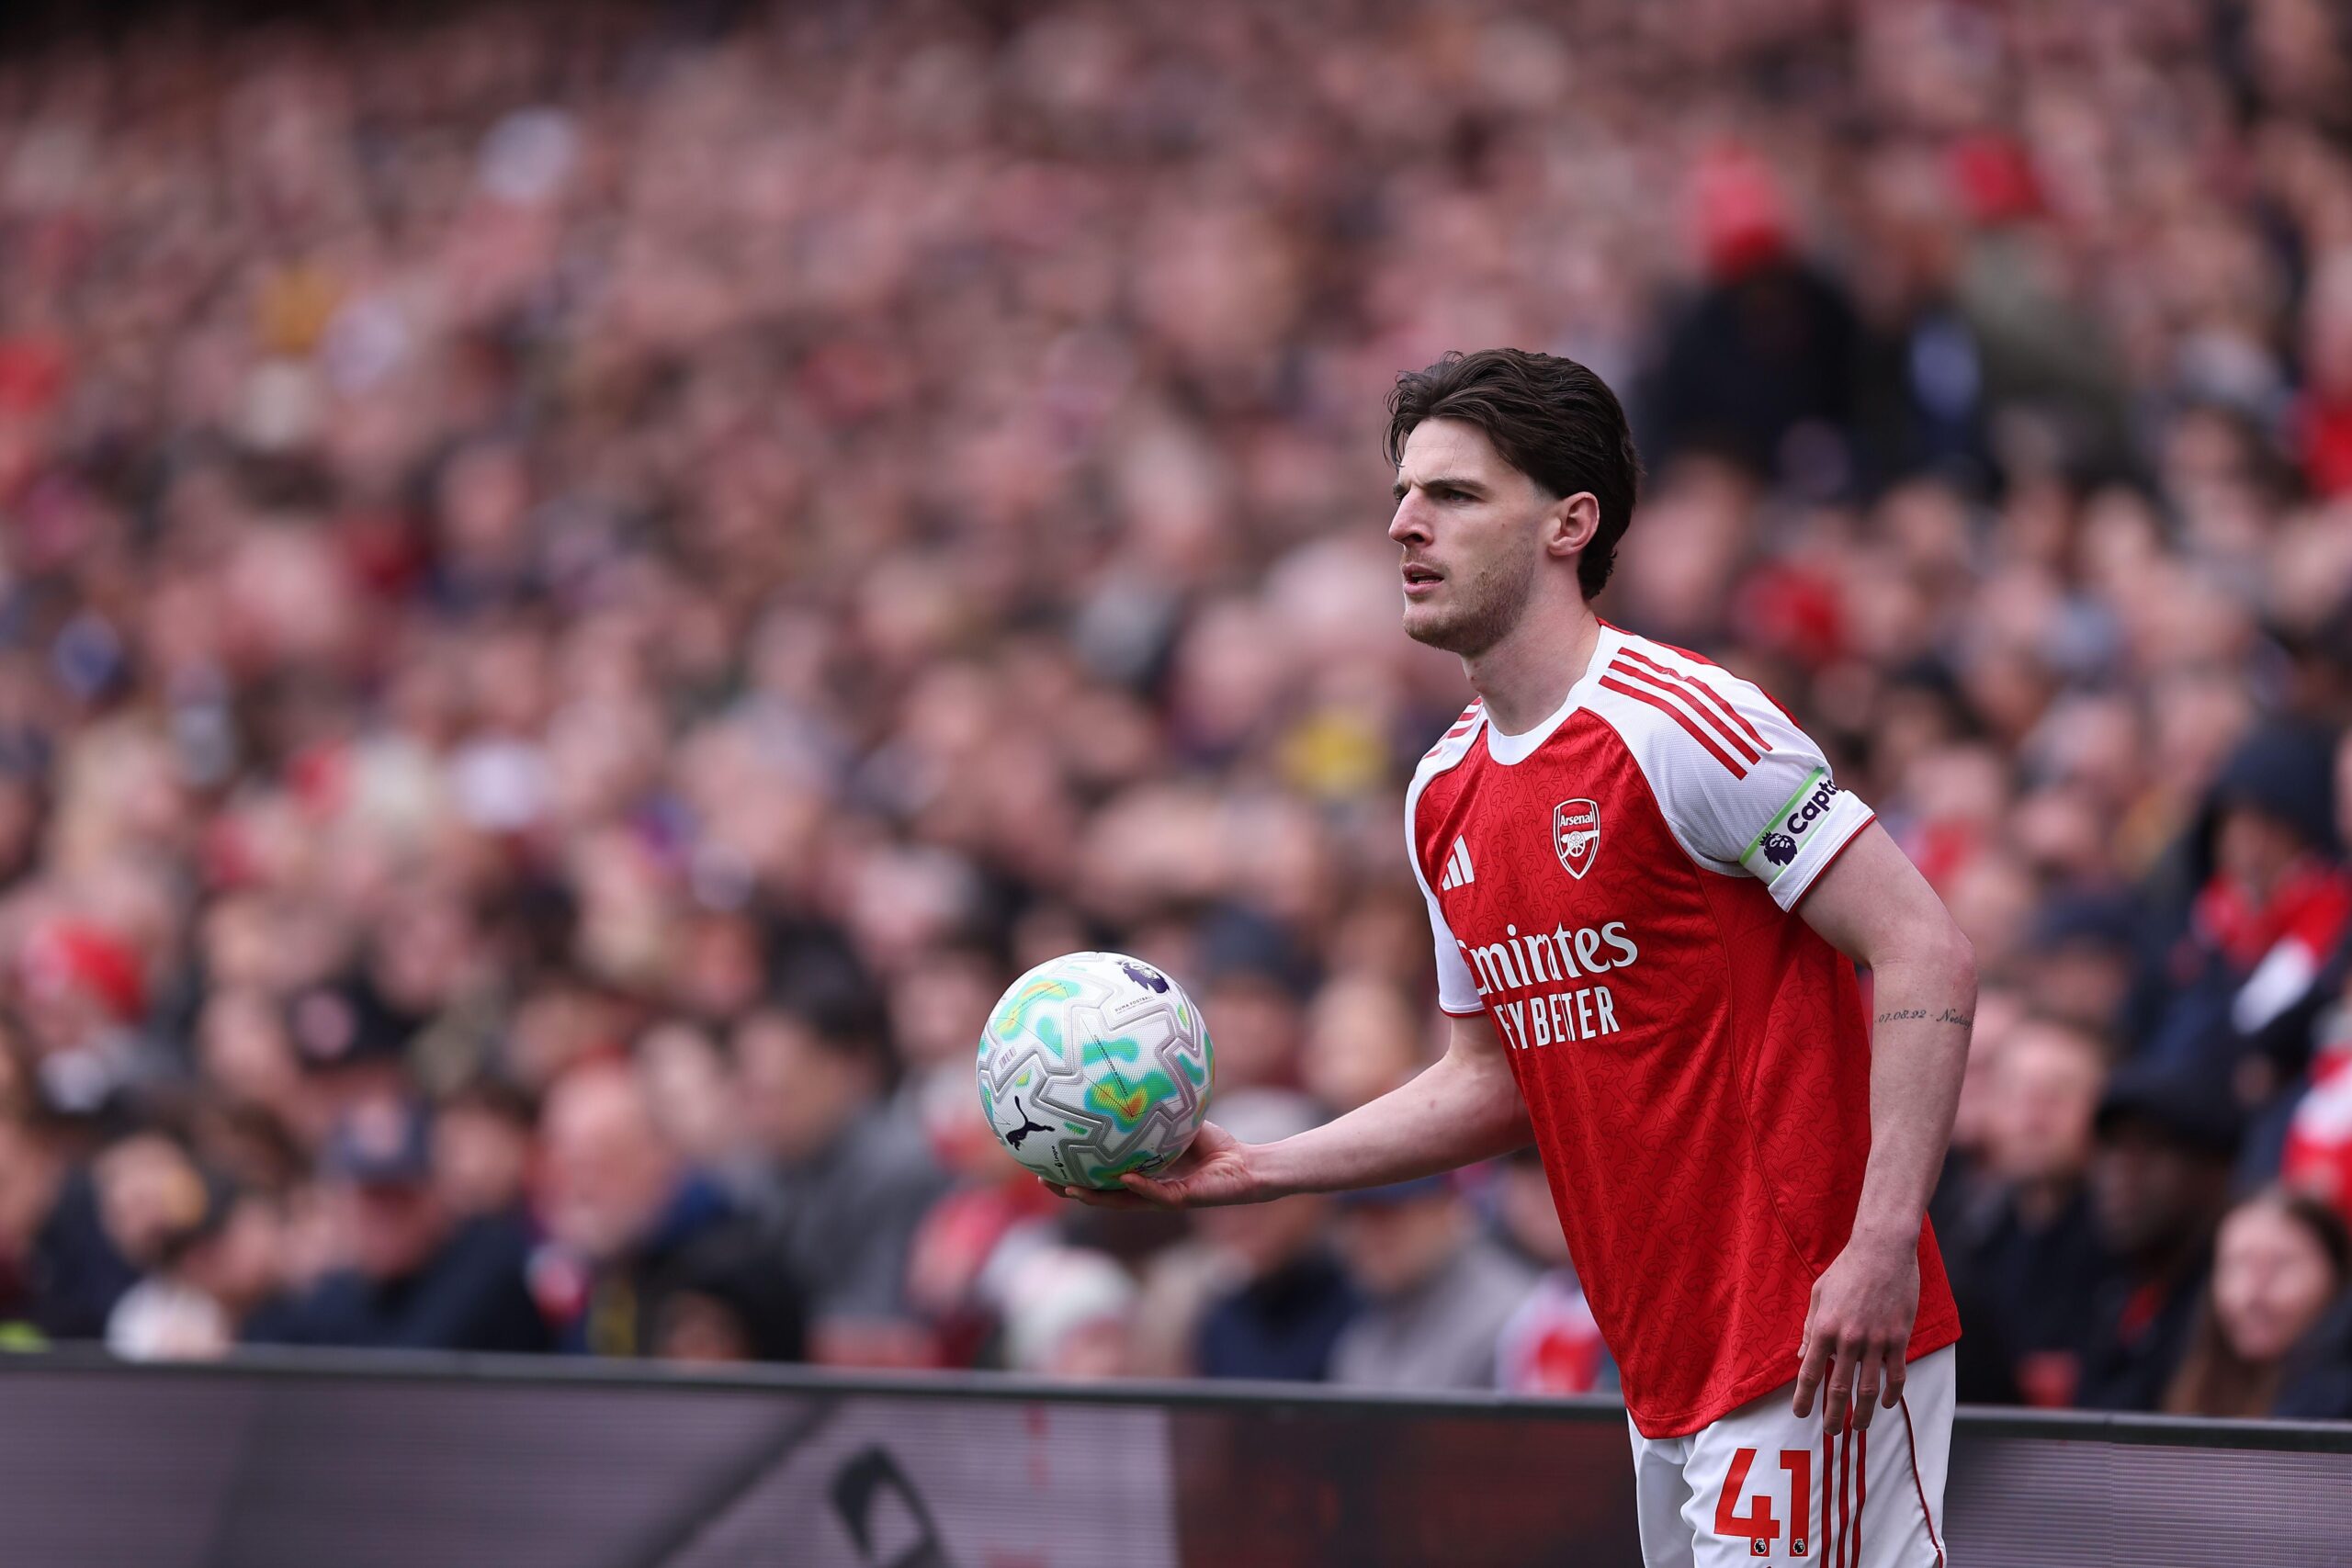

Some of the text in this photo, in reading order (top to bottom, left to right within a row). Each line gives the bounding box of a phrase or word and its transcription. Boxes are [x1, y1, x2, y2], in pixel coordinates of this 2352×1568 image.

[1559, 810, 1594, 827] Arsenal
[1493, 986, 1620, 1050] FY BETER
[1713, 1447, 1812, 1558] 41
